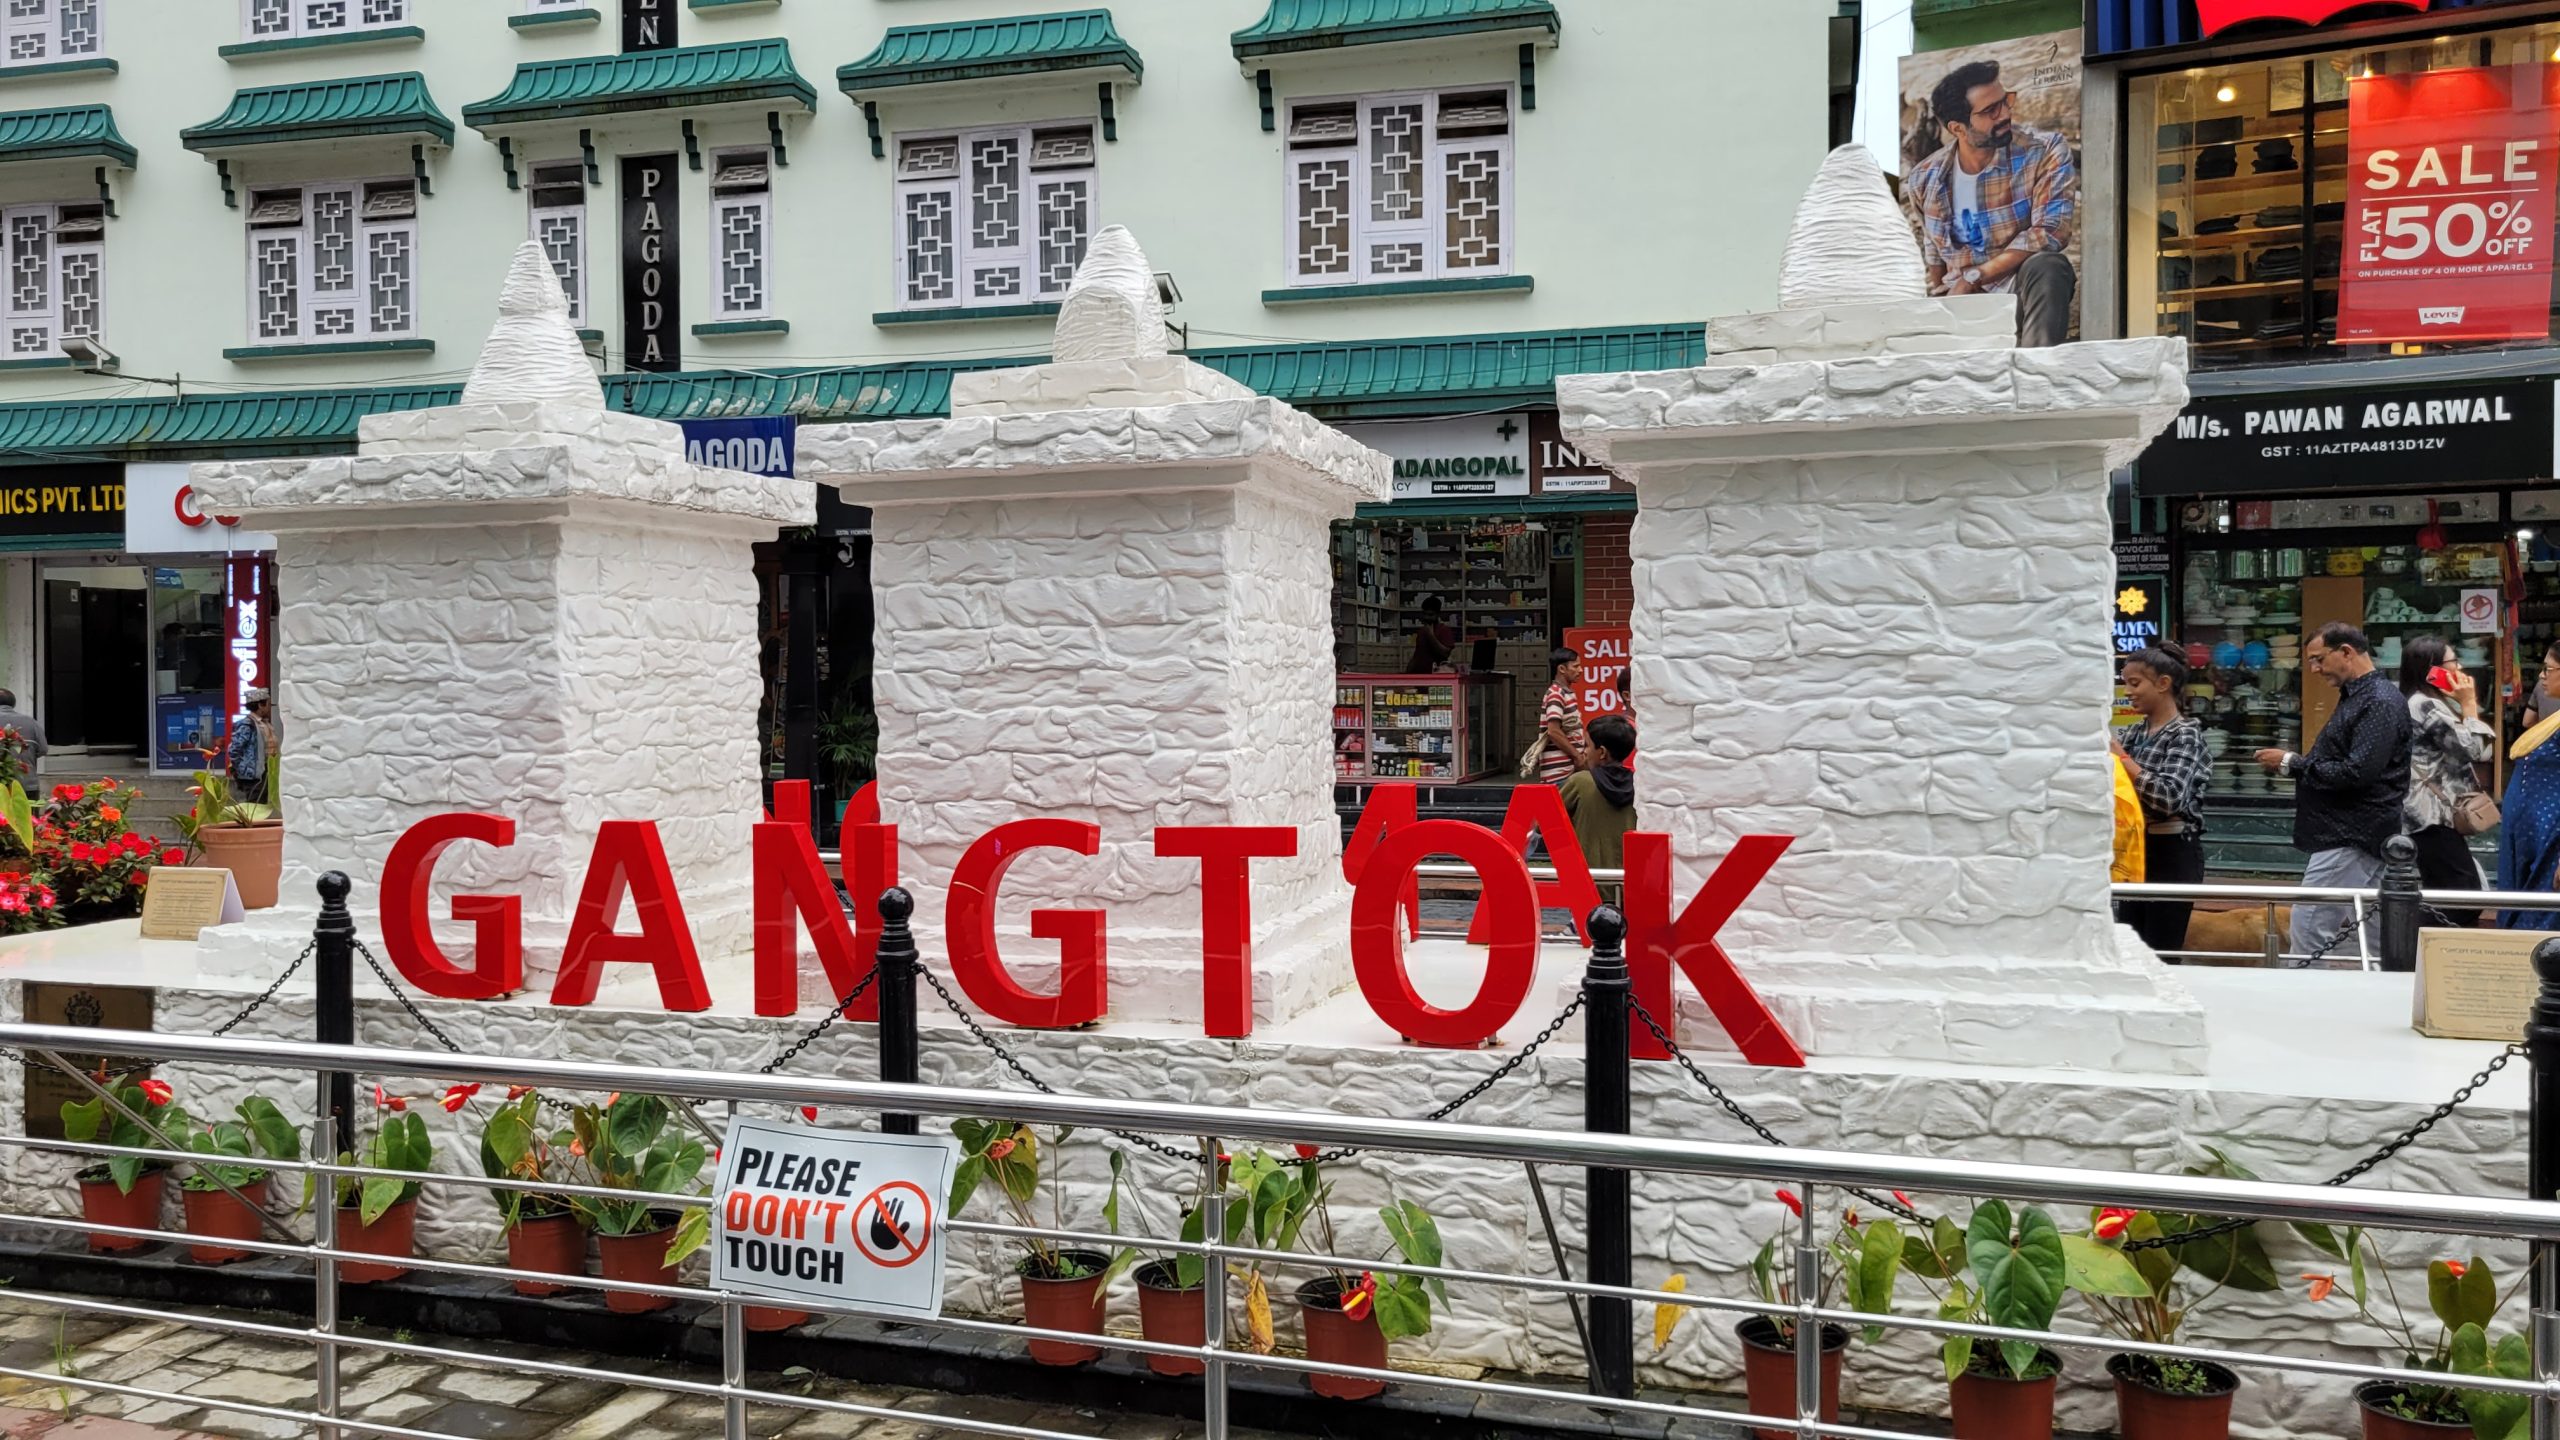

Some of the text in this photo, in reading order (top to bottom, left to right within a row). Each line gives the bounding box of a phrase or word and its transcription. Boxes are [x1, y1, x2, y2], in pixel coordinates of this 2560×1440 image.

[2033, 64, 2071, 76] INDIAN
[2364, 140, 2538, 190] SALE
[2360, 200, 2533, 262] FLAT 50% OFF
[641, 169, 663, 363] PAGODA
[2358, 263, 2534, 278] ON PURCHASE OF 4 OR MORE APPARELS
[2177, 396, 2512, 440] M/s. PAWAN AGARWAL
[2261, 445, 2292, 458] GST
[2304, 437, 2446, 456] 11AZTPA4813D1ZV
[42, 486, 86, 513] PVT.
[91, 485, 126, 512] LTD
[2116, 637, 2147, 652] SPA
[379, 812, 1806, 1069] GANGTOK
[735, 1147, 861, 1197] PLEASE
[726, 1190, 846, 1244] DON'T
[726, 1236, 844, 1285] TOUCH
